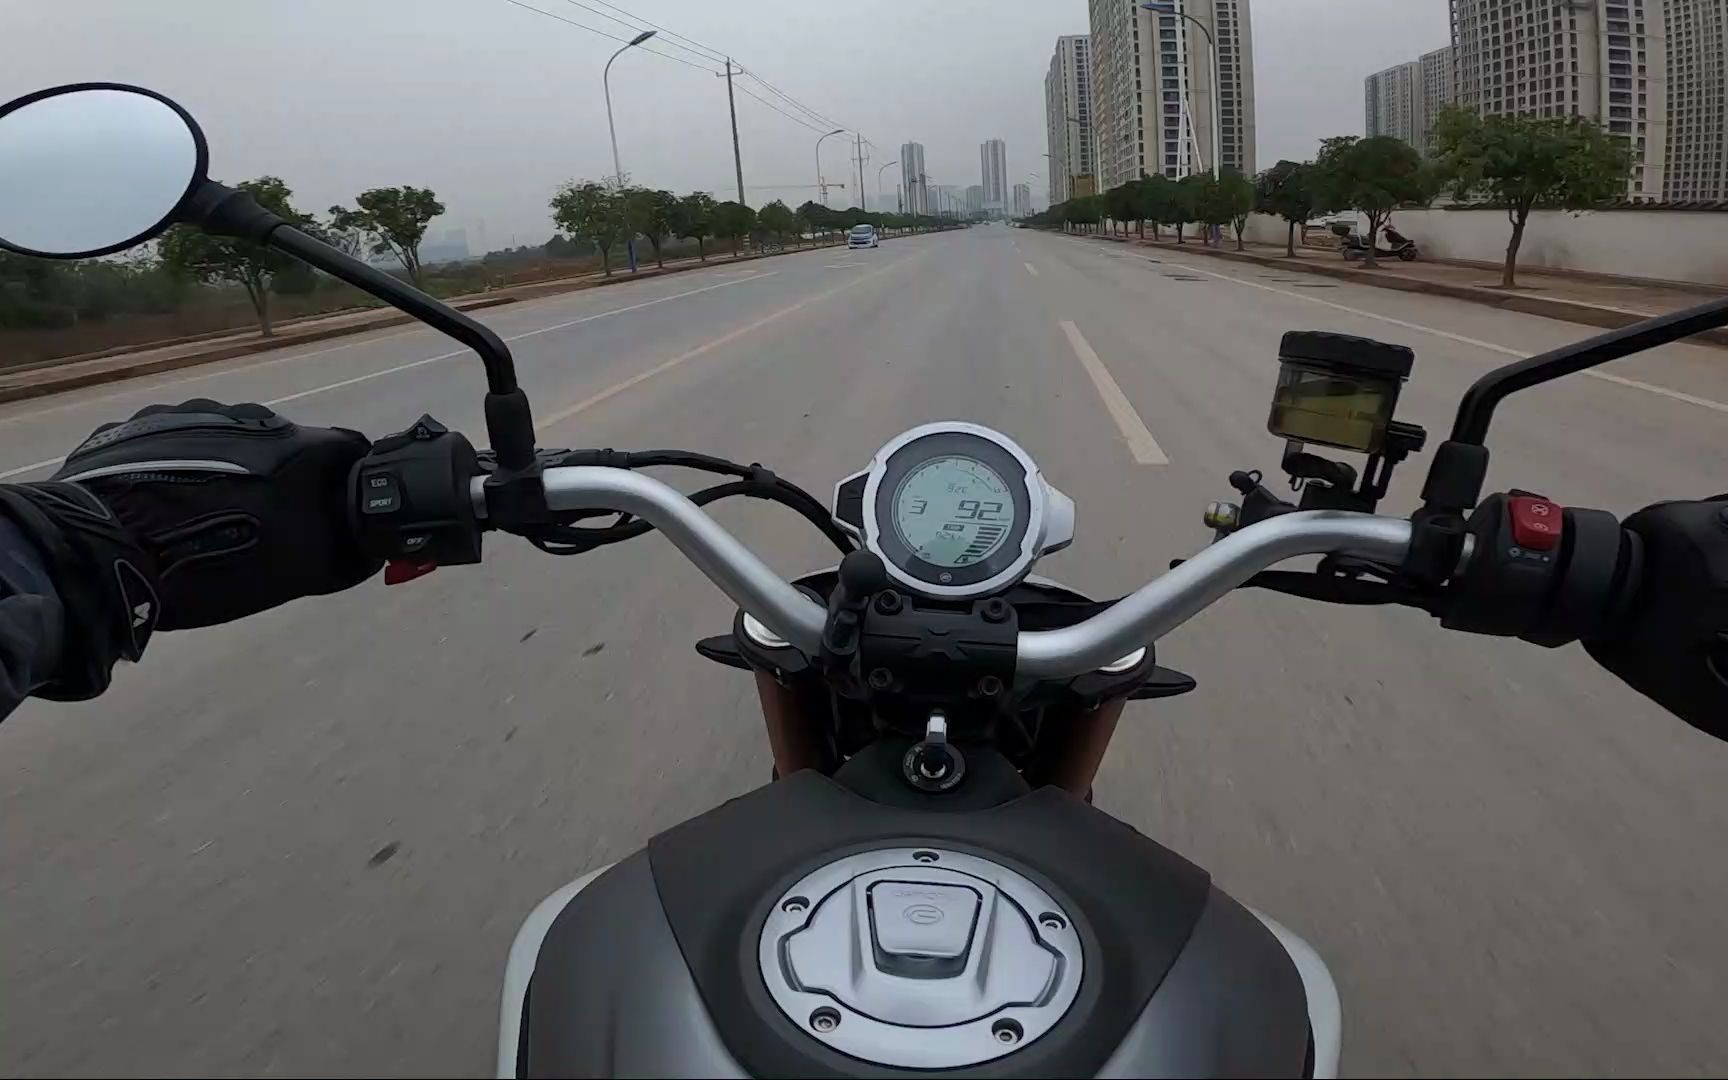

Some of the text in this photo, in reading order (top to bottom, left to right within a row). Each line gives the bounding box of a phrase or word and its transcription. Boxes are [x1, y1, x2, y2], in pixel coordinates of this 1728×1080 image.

[371, 478, 388, 487] ECO
[369, 497, 392, 507] SPORT
[908, 500, 929, 515] 3
[954, 499, 1004, 521] 92
